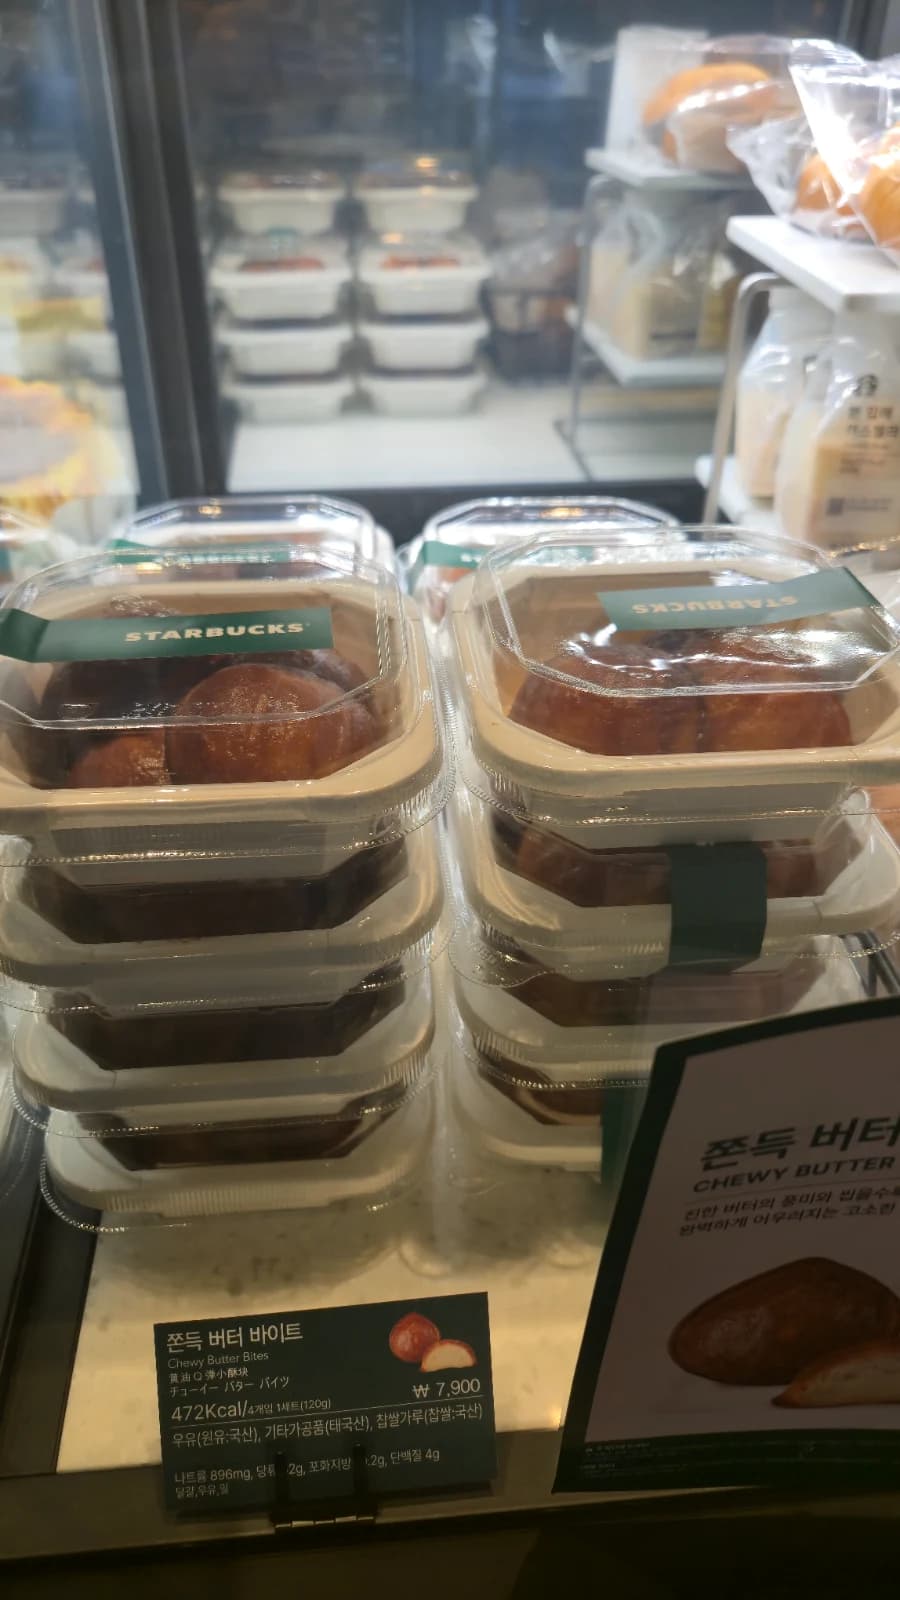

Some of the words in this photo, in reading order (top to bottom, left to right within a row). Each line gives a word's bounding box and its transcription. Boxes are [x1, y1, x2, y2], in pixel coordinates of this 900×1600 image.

[631, 594, 800, 616] STARBUCKS
[124, 622, 306, 644] STARBUCKS
[701, 1127, 796, 1172] 쫀득
[810, 1117, 900, 1152] 버터
[693, 1166, 789, 1193] CHEWY
[795, 1156, 896, 1178] BUTTER
[723, 1197, 776, 1215] 버터의
[166, 1331, 204, 1353] 쫀득
[208, 1327, 243, 1349] 버터
[249, 1322, 304, 1345] 바이트
[168, 1357, 205, 1370] Chewy
[207, 1354, 239, 1366] Butter
[243, 1351, 269, 1363] Bites
[435, 1378, 481, 1398] 7,900
[172, 1426, 261, 1448] 우유(원유:국산),
[264, 1416, 373, 1439] 기타가공품(태국산),
[376, 1403, 483, 1429] 찹쌀가루(찹쌀:국산)
[210, 1467, 254, 1482] 896mg,
[390, 1448, 422, 1465] 단백질
[425, 1448, 440, 1462] 4g
